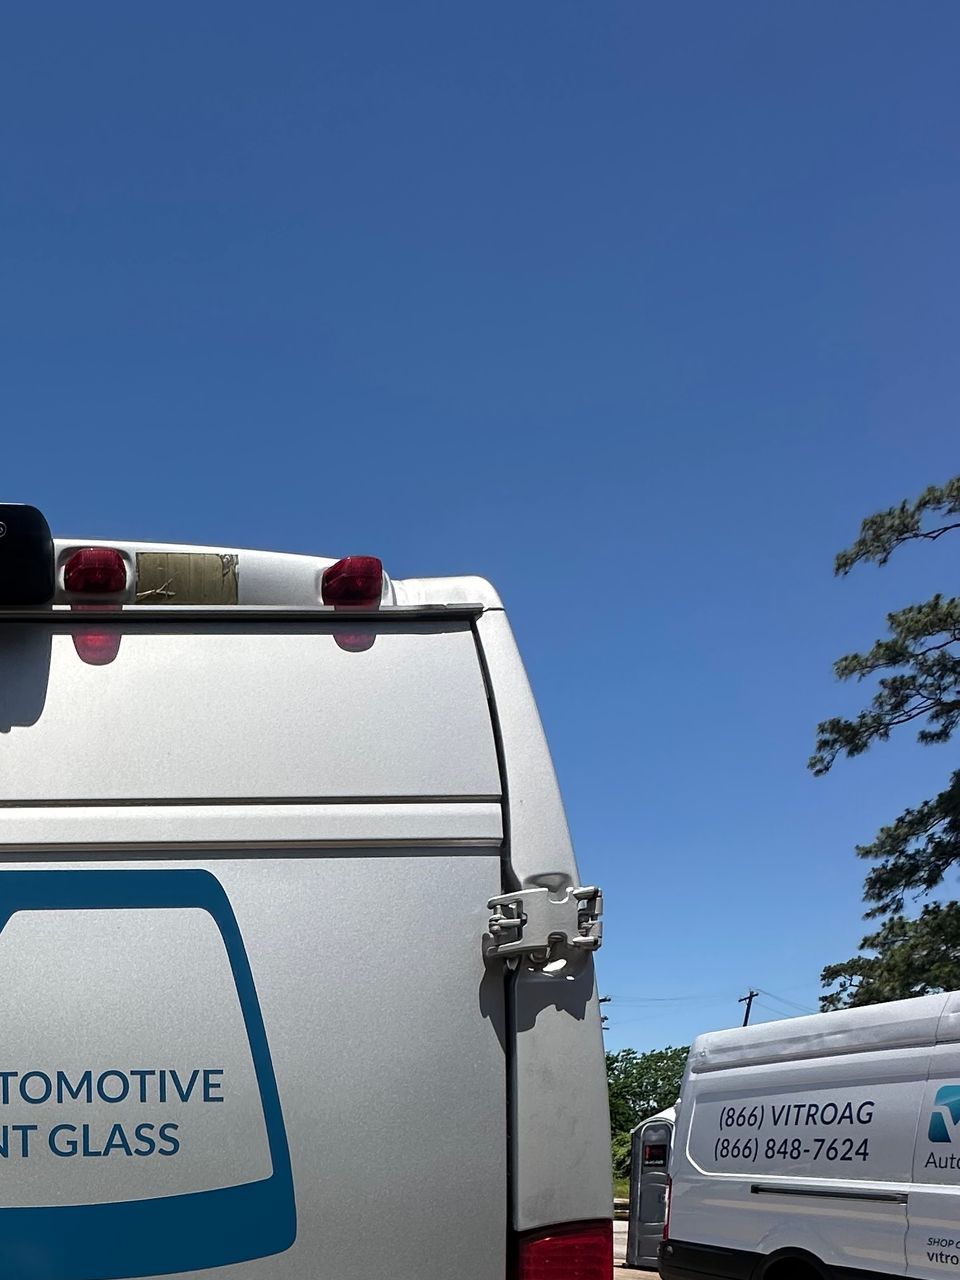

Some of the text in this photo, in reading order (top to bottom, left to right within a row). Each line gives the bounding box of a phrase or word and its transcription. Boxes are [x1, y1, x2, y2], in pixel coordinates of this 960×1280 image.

[719, 1101, 875, 1131] (866) VITROAG
[49, 1123, 180, 1158] GLASS
[714, 1137, 870, 1162] (866) 848-7624
[927, 1237, 954, 1248] SHOP
